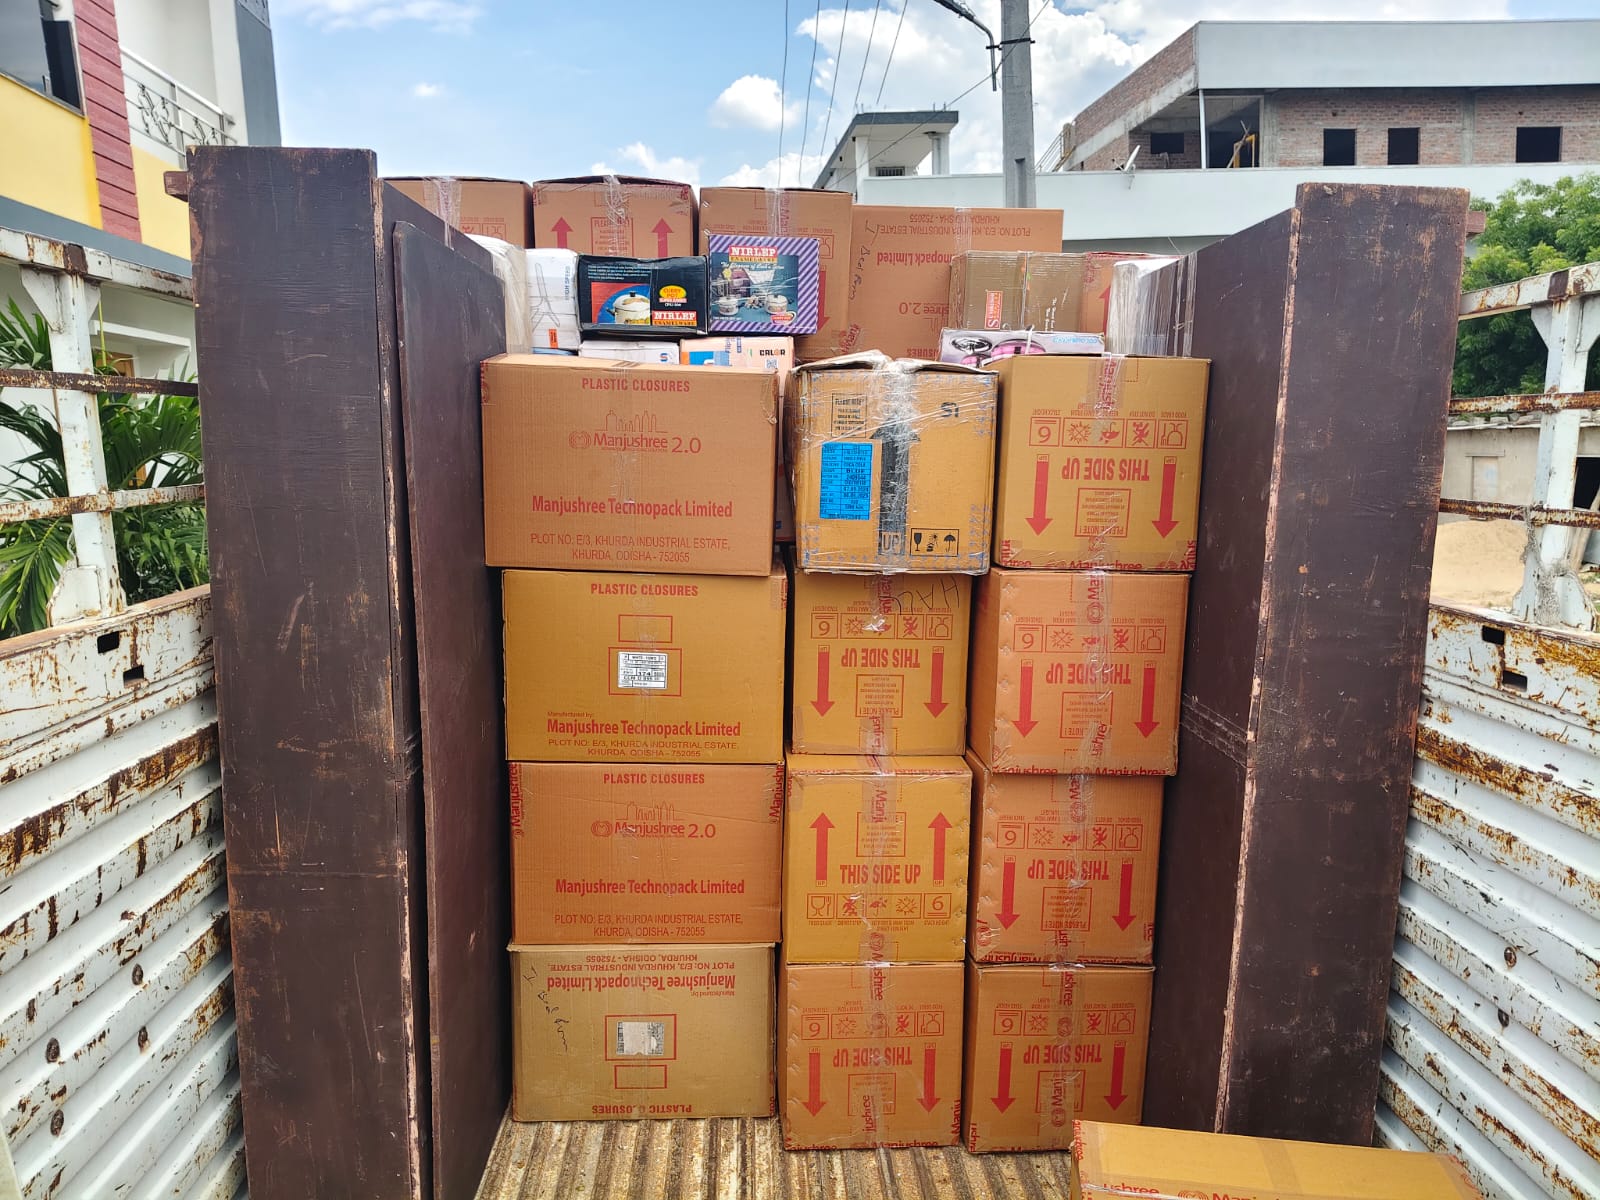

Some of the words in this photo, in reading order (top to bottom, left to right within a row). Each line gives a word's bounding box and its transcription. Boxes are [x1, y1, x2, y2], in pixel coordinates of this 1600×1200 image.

[909, 213, 934, 222] 752055
[908, 224, 951, 235] INDUSTRIAL
[1011, 227, 1031, 236] PLOT
[731, 246, 776, 257] NIRLEP
[877, 250, 913, 266] Limited
[913, 251, 954, 267] nopack
[654, 311, 696, 320] NIRLEP
[899, 302, 920, 315] 2.0
[923, 302, 949, 318] shree
[581, 377, 628, 391] PLASTIC
[632, 378, 690, 393] CLOSURES
[593, 432, 668, 452] Manjushree
[671, 436, 702, 454] 2.0
[1061, 456, 1081, 481] UP
[1083, 457, 1115, 481] SIDE
[1119, 458, 1150, 481] THIS
[532, 495, 606, 517] Manjushree
[607, 497, 682, 520] Technopack
[685, 500, 732, 518] Limited
[530, 532, 556, 545] PLOT
[594, 534, 635, 547] KHURDA
[636, 536, 691, 549] INDUSTRIAL
[883, 533, 900, 551] UP
[616, 550, 651, 562] ODISHA
[658, 551, 690, 563] 752055
[590, 583, 638, 595] PLASTIC
[641, 584, 699, 597] CLOSURES
[1021, 632, 1035, 650] 6
[840, 647, 858, 668] UP
[861, 647, 889, 668] SIDE
[892, 648, 920, 668] THIS
[1045, 662, 1064, 684] UP
[1067, 663, 1098, 685] SIDE
[547, 718, 619, 736] Manjushree
[621, 720, 692, 738] Technopack
[695, 722, 741, 738] Limited
[548, 738, 574, 747] PLOT
[610, 740, 649, 749] KHURDA
[651, 740, 702, 750] INDUSTRIAL
[630, 748, 665, 757] ODISHA
[671, 749, 701, 758] 752055
[603, 773, 648, 784] PLASTIC
[650, 773, 705, 785] CLOSURES
[614, 820, 685, 838] Manjushree
[687, 823, 717, 838] 2.0
[1004, 830, 1017, 846] 6
[839, 864, 869, 884] THIS
[872, 864, 901, 884] SIDE
[904, 864, 922, 884] UP
[1027, 858, 1045, 880] UP
[1047, 859, 1078, 880] SIDE
[555, 878, 626, 897] Manjushree
[627, 879, 698, 897] Technopack
[700, 879, 744, 895] Limited
[932, 895, 944, 911] 6
[554, 914, 578, 925] PLOT
[615, 914, 653, 925] KHURDA
[654, 914, 706, 925] INDUSTRIAL
[635, 927, 670, 937] ODISHA
[676, 926, 706, 937] 752055
[586, 954, 616, 964] 752055
[622, 954, 656, 963] ODISHA
[639, 962, 676, 971] KHURDA
[711, 961, 735, 970] PLOT
[590, 963, 638, 972] INDUSTRIAL
[547, 975, 592, 992] Limited
[594, 973, 666, 992] Technopack
[667, 972, 736, 991] Manjushree
[873, 967, 887, 1001] ushree
[1063, 971, 1077, 1007] ushree
[809, 1022, 821, 1037] 6
[1001, 1017, 1014, 1033] 6
[832, 1048, 849, 1068] UP
[852, 1047, 881, 1067] SIDE
[884, 1046, 913, 1066] THIS
[1023, 1045, 1040, 1065] UP
[1042, 1044, 1071, 1064] SIDE
[1074, 1044, 1103, 1063] THIS
[592, 1104, 646, 1114] COSURES
[648, 1104, 692, 1113] PLASTIC
[862, 1095, 876, 1133] jushree
